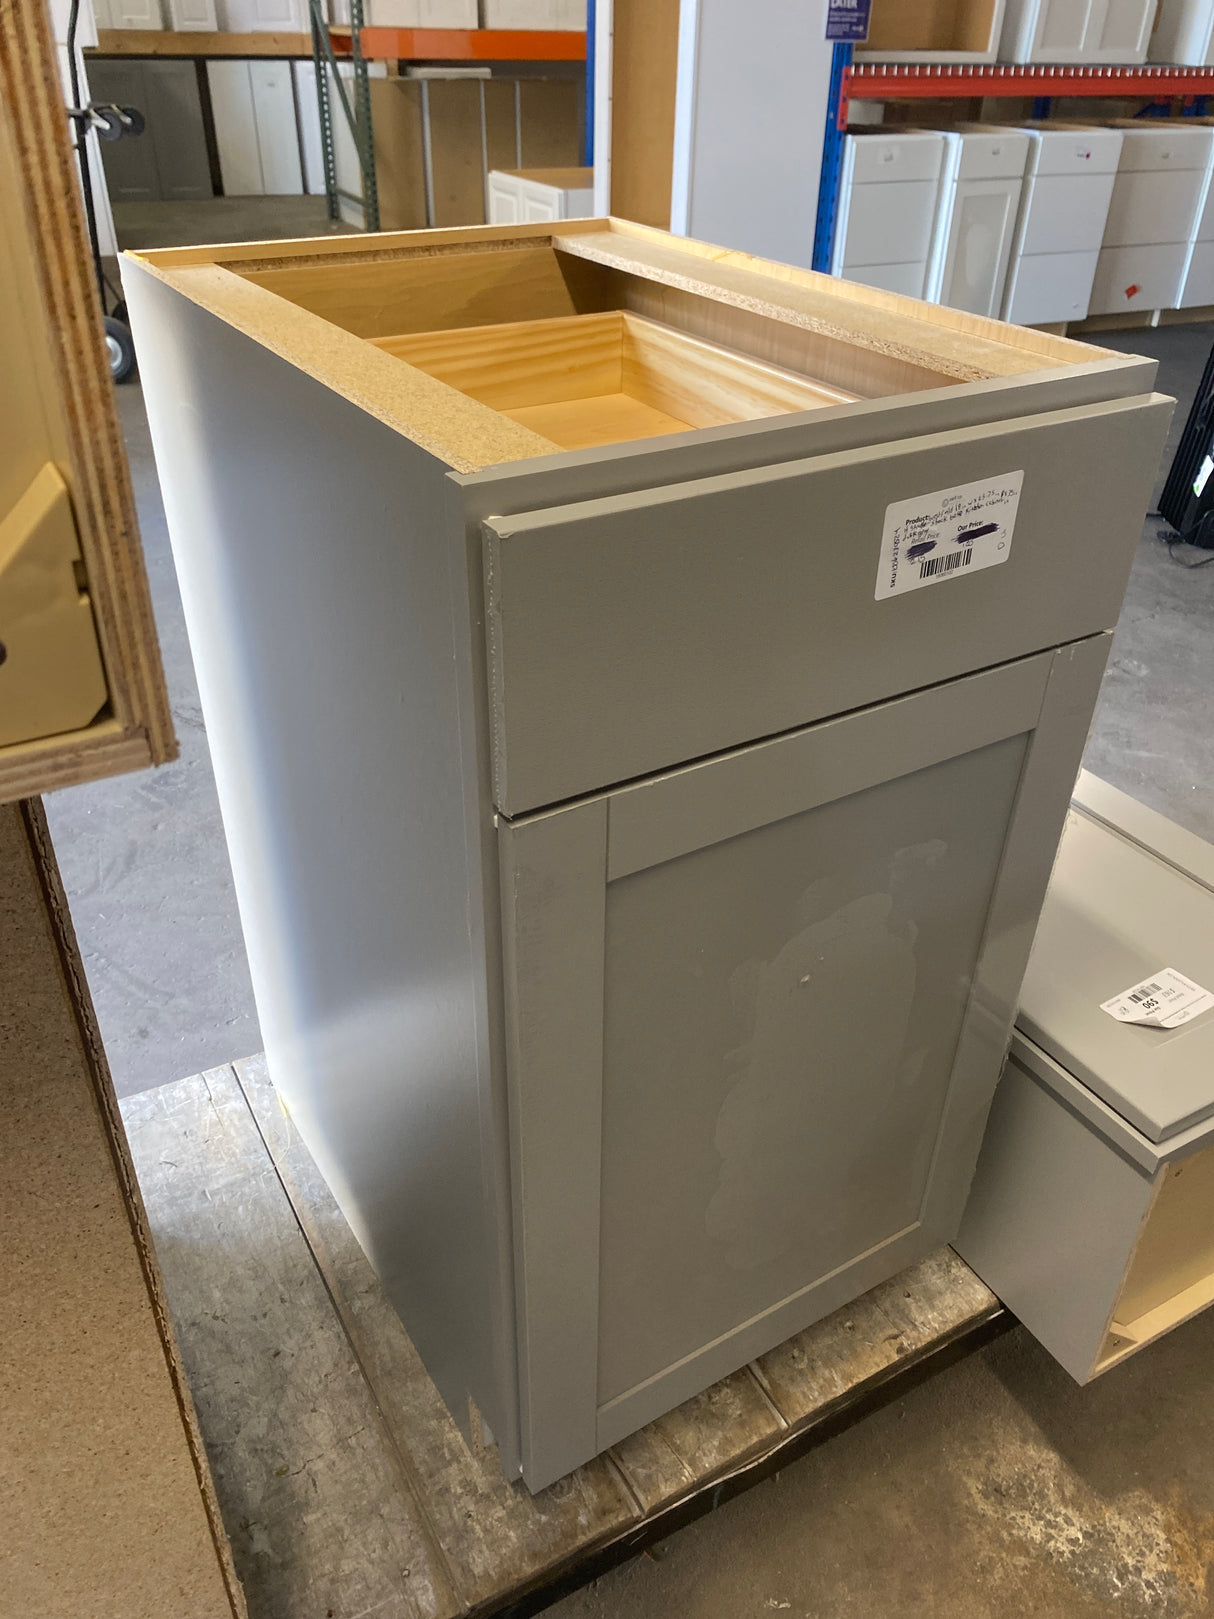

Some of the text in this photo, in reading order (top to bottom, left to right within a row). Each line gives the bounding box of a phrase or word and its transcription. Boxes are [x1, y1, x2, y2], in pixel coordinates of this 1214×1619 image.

[905, 514, 929, 526] Product:
[957, 520, 984, 532] Our Price:
